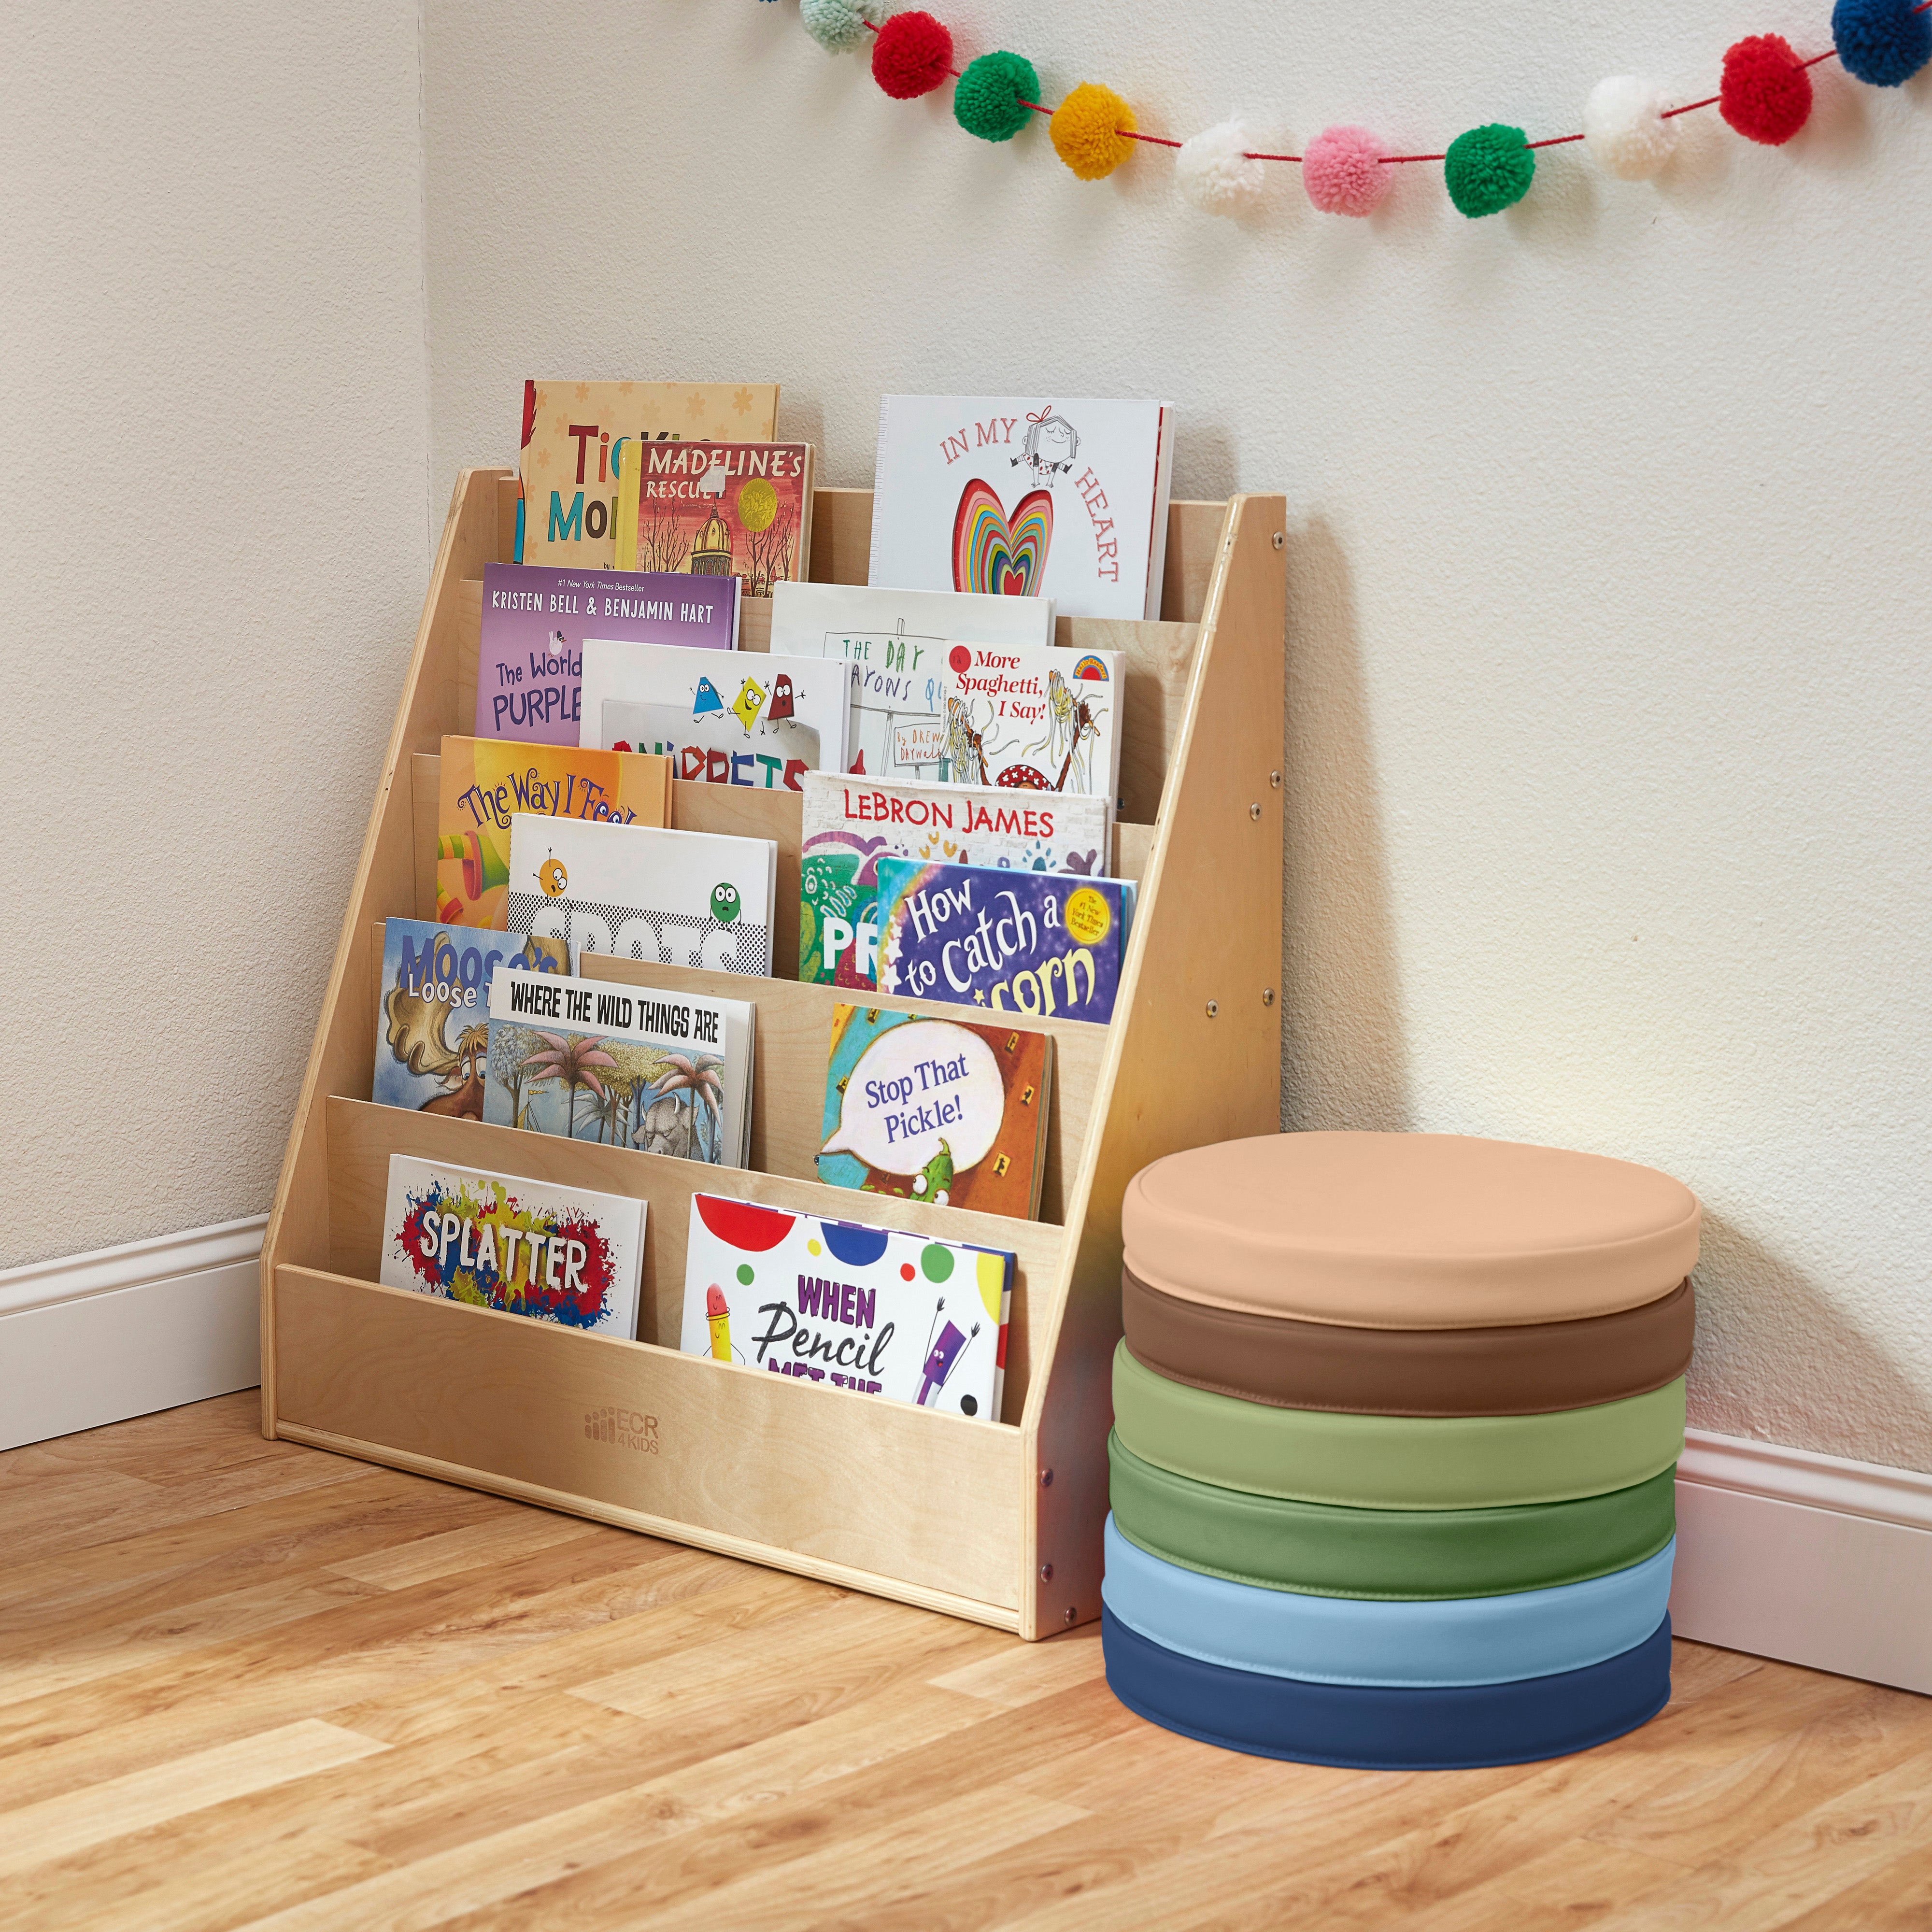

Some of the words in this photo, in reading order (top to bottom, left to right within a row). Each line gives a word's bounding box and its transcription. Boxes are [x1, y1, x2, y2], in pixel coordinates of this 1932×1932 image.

[646, 481, 712, 499] RESCU
[939, 428, 970, 465] IN
[975, 418, 1017, 447] MY
[1074, 467, 1120, 582] HEART
[548, 491, 618, 542] Mo
[567, 580, 581, 588] New
[582, 580, 595, 589] York
[597, 581, 613, 590] Times
[615, 582, 644, 592] Bestseller
[492, 590, 543, 611] KRISTEN
[550, 594, 579, 614] BELL
[586, 597, 597, 616] &
[604, 597, 673, 621] BENJAMIN
[680, 603, 713, 624] HART
[496, 663, 522, 686] The
[530, 649, 582, 679] World
[843, 639, 872, 660] THE
[885, 640, 924, 673] DAY
[974, 651, 1020, 670] More
[956, 673, 1043, 698] Spaghetti,
[493, 685, 581, 731] PURPLE
[998, 700, 1007, 716] I
[1009, 703, 1046, 724] Say!
[913, 729, 940, 743] DREW
[458, 784, 511, 829] The
[507, 768, 561, 816] Way
[563, 773, 577, 813] I
[844, 789, 952, 828] LEBRON
[962, 800, 1054, 838] JAMES
[905, 879, 972, 943] How
[1072, 908, 1085, 920] York
[1087, 915, 1103, 928] Times
[1087, 905, 1101, 915] New
[1088, 895, 1096, 904] The
[905, 959, 937, 995] to
[942, 891, 1037, 993] Catch
[1044, 895, 1060, 929] a
[1071, 917, 1099, 936] Bestseller
[409, 973, 478, 1008] Loose
[981, 948, 1095, 1016] corn
[511, 981, 561, 1018] WHERE
[566, 989, 591, 1023] THE
[597, 994, 632, 1028] WILD
[638, 1000, 689, 1038] THINGS
[694, 1009, 719, 1043] ARE
[865, 1074, 913, 1108] Stop
[914, 1053, 969, 1091] That
[883, 1094, 964, 1143] Pickle!
[419, 1210, 592, 1294] SPLATTER
[797, 1274, 877, 1329] WHEN
[751, 1300, 895, 1377] Pencil
[617, 1408, 658, 1439] ECR
